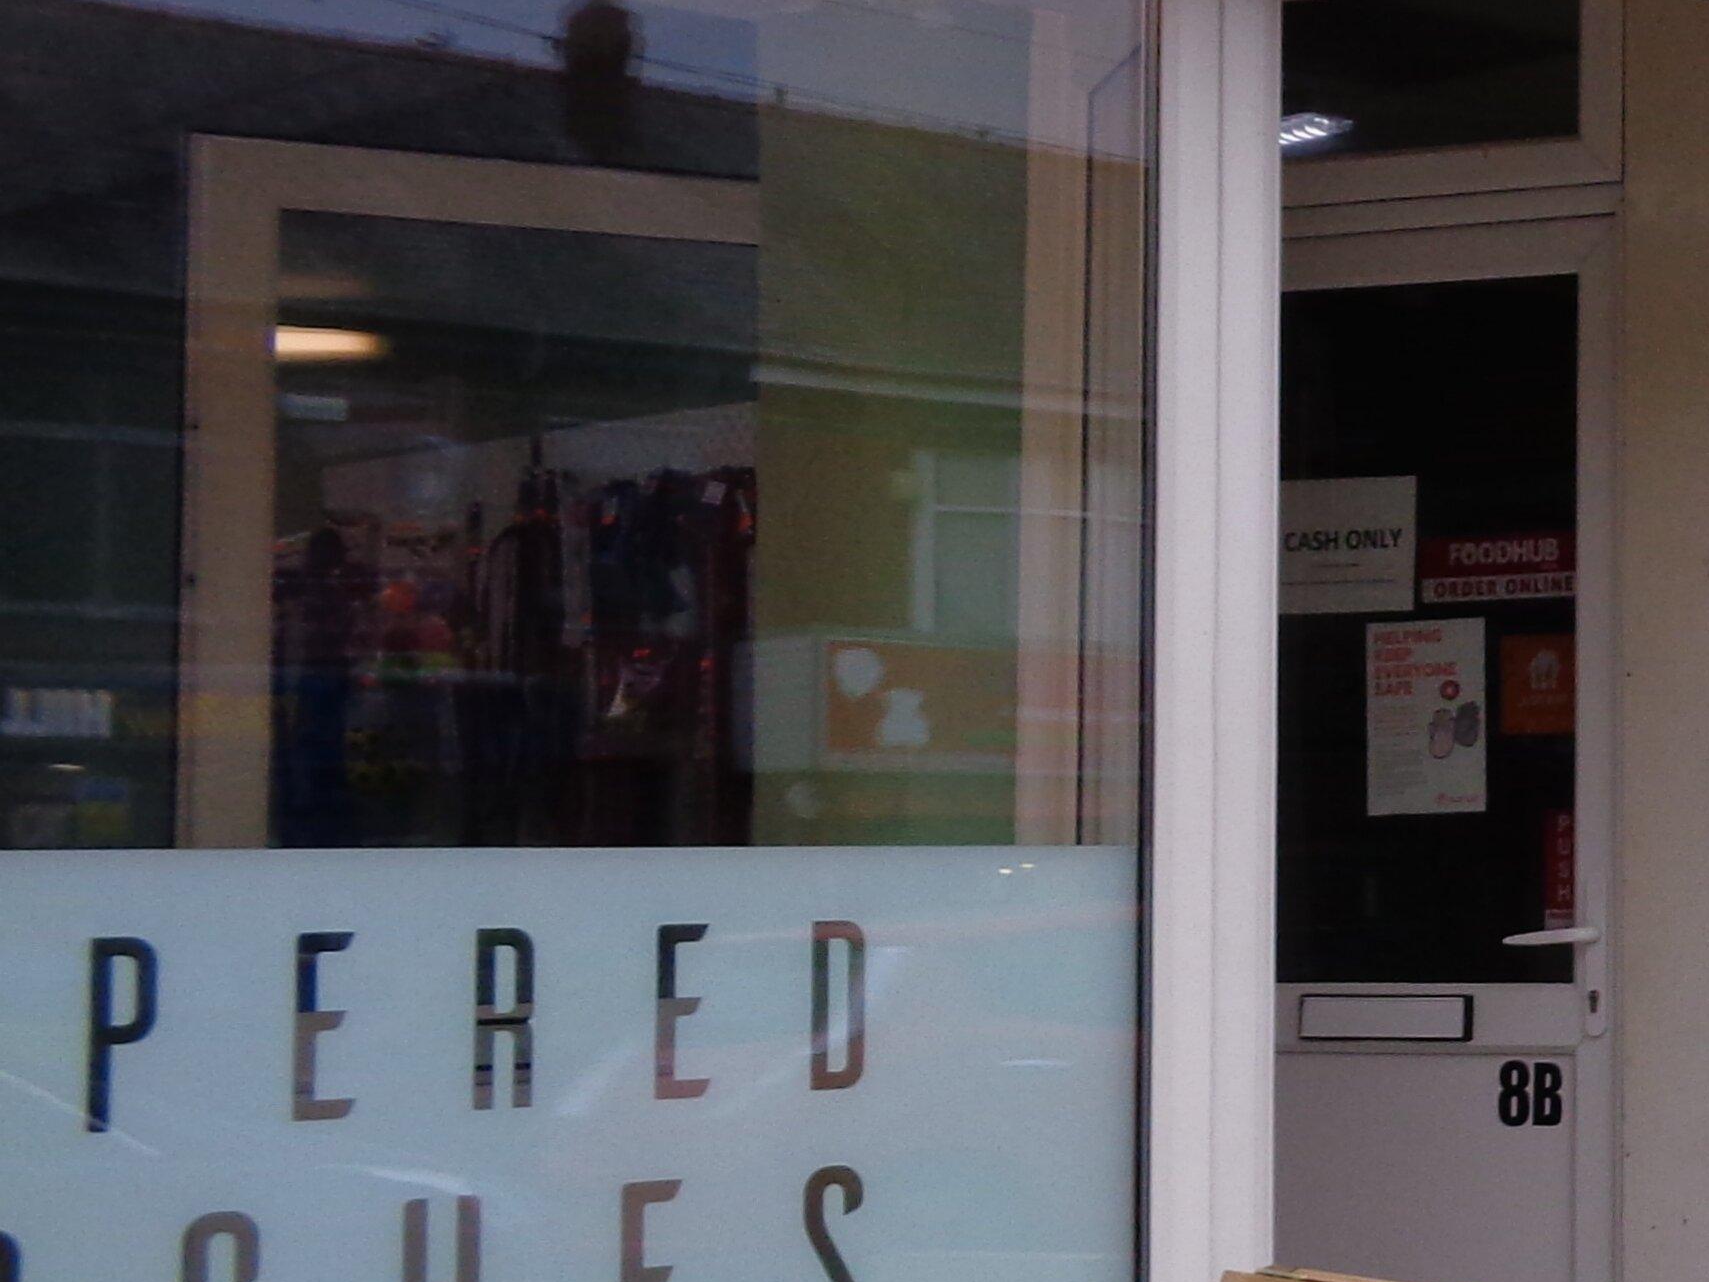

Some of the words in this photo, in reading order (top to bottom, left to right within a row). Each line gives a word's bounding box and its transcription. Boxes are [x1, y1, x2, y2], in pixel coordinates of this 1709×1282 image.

[1284, 531, 1339, 553] CASH
[1344, 528, 1403, 550] ONLY
[1449, 537, 1560, 567] FOODHUB
[1433, 579, 1498, 599] ORDER
[1503, 574, 1574, 596] ONLINE
[1498, 1059, 1562, 1128] 8B
